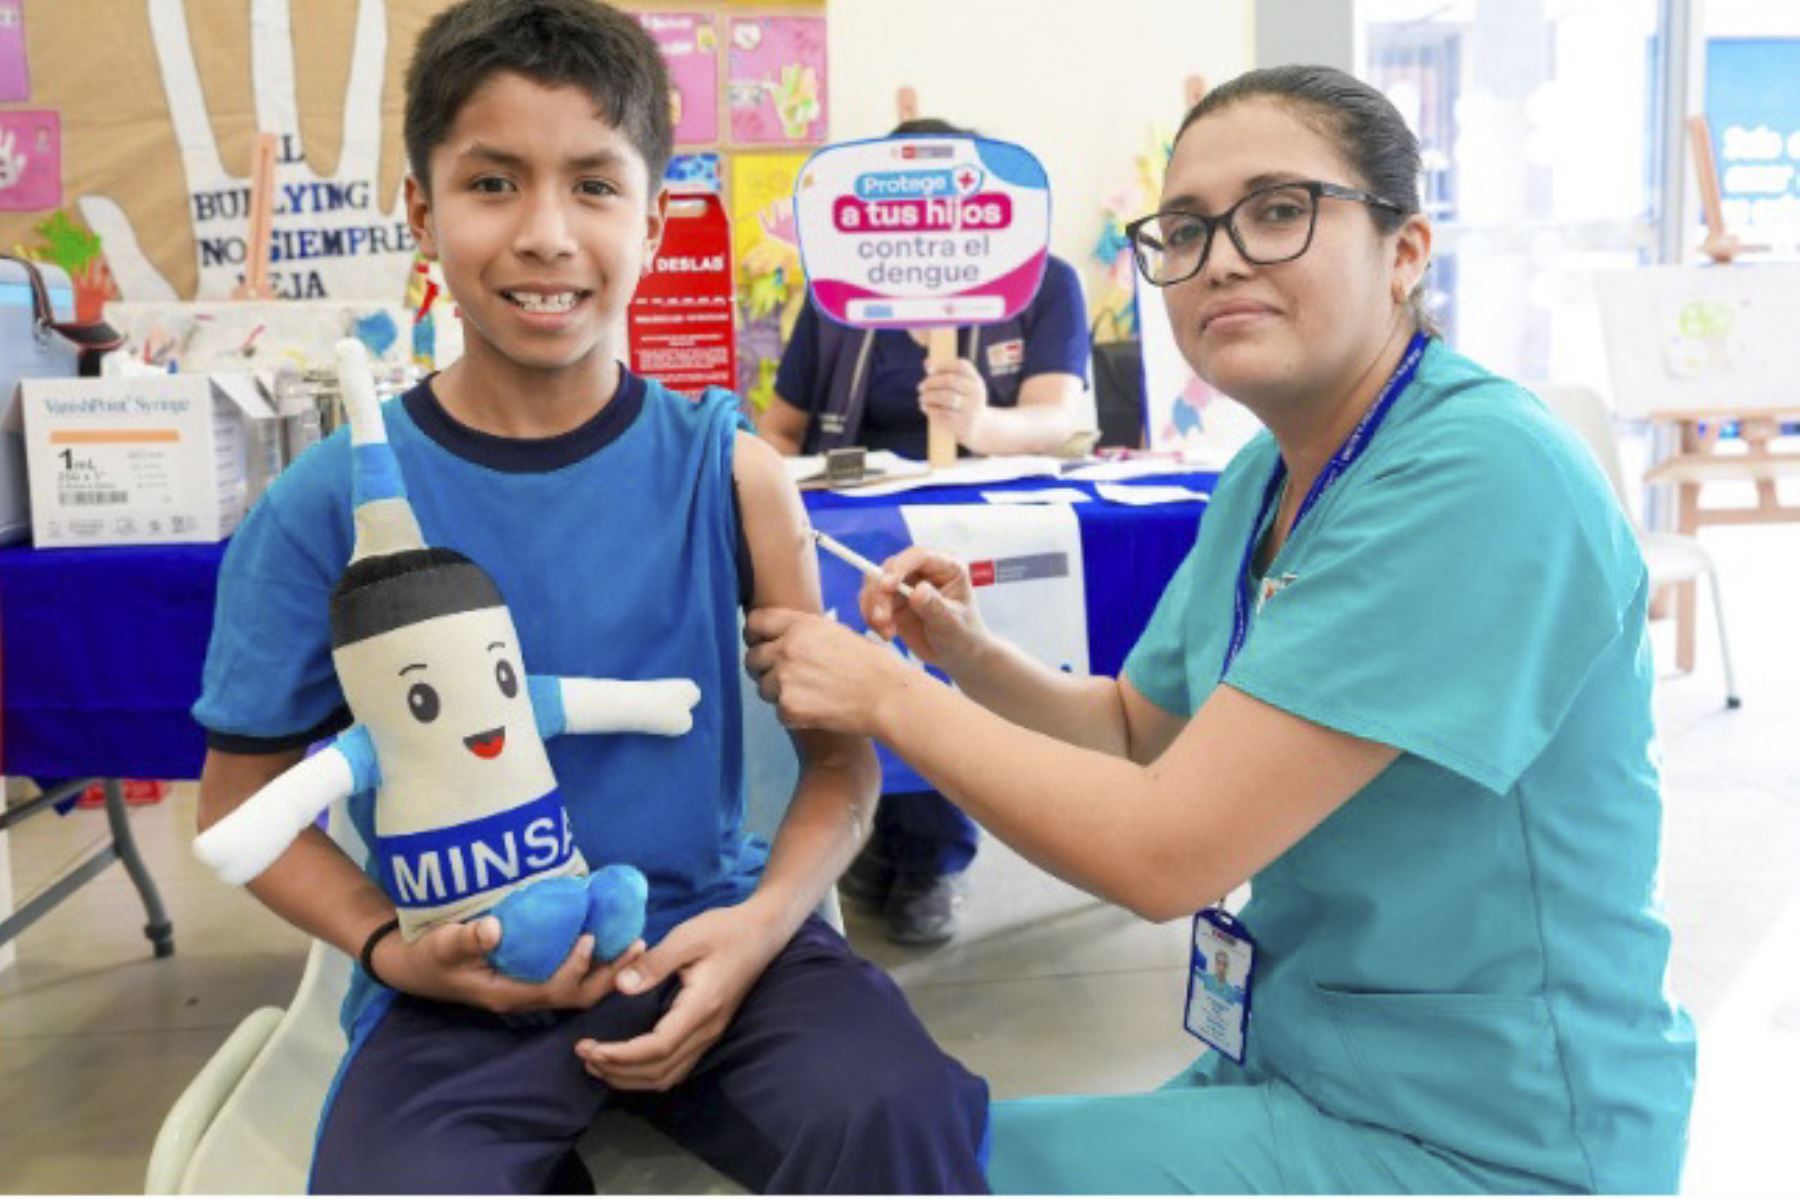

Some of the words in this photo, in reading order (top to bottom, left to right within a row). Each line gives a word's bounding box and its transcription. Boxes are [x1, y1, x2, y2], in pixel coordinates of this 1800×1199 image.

[864, 176, 948, 195] Protege
[841, 207, 860, 227] a
[866, 201, 919, 226] tus
[926, 197, 1001, 231] hijos
[858, 238, 956, 259] contra
[965, 235, 990, 255] el
[867, 263, 979, 288] dengue
